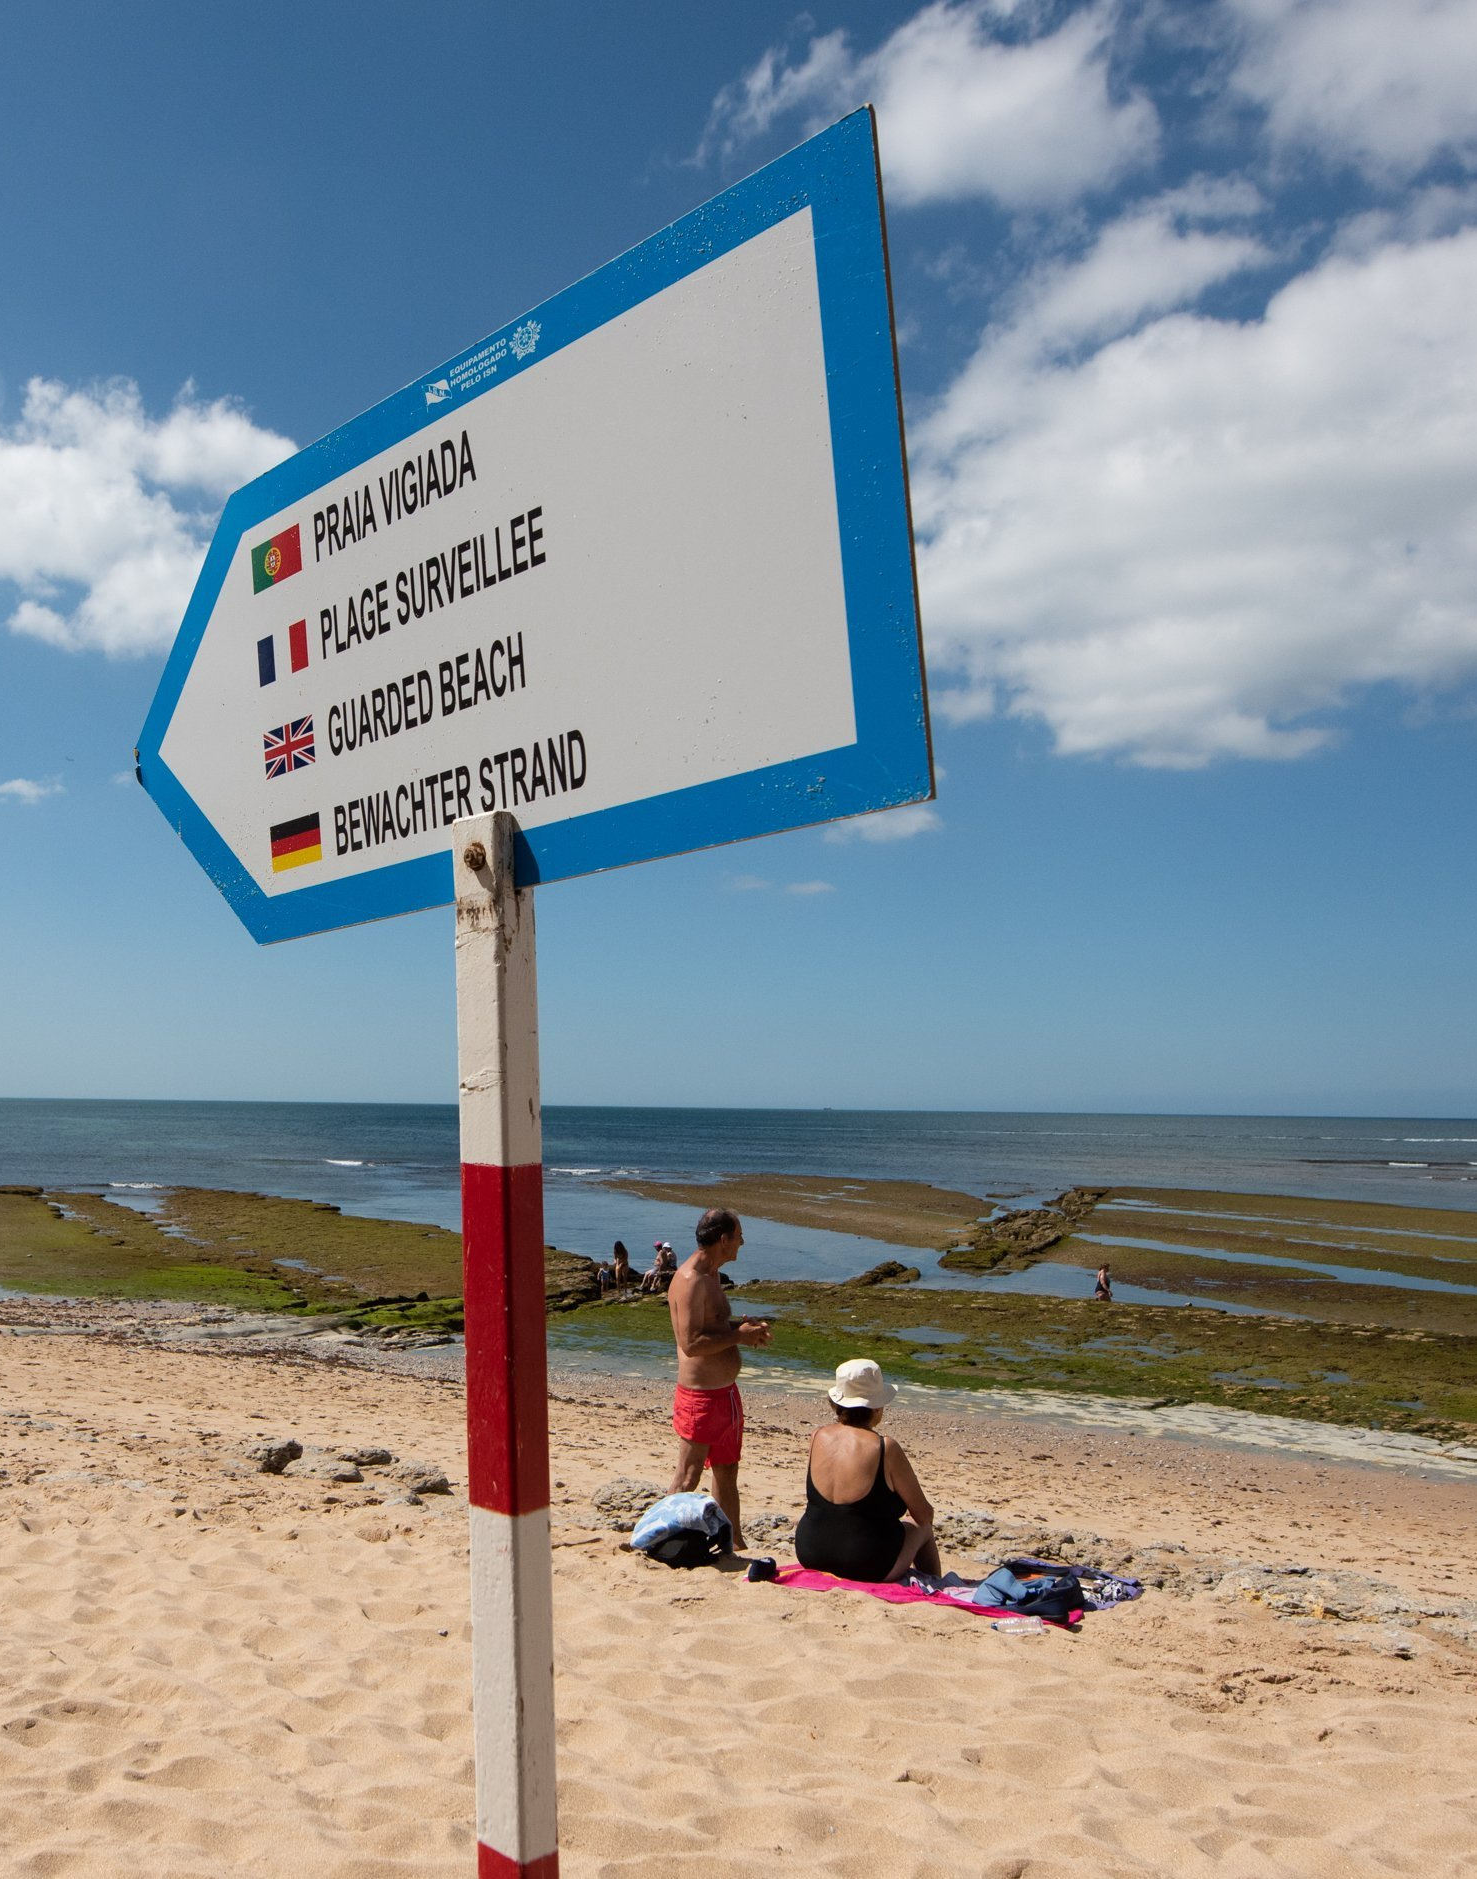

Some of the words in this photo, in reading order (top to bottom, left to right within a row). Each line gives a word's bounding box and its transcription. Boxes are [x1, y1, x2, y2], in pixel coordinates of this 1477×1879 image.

[449, 338, 507, 377] EQUIPAMENTO
[450, 348, 508, 387] HOMOLOGADO
[461, 374, 481, 391] PELO
[483, 365, 497, 378] ISN
[314, 485, 377, 562] PRAIA
[379, 430, 476, 525] VIGIADA
[320, 580, 391, 660] PLAGE
[395, 505, 546, 625] SURVEILLEE
[328, 670, 433, 756] GUARDED
[439, 631, 526, 717] BEACH
[334, 765, 473, 856] BEWACHTER
[479, 729, 587, 811] STRAND
